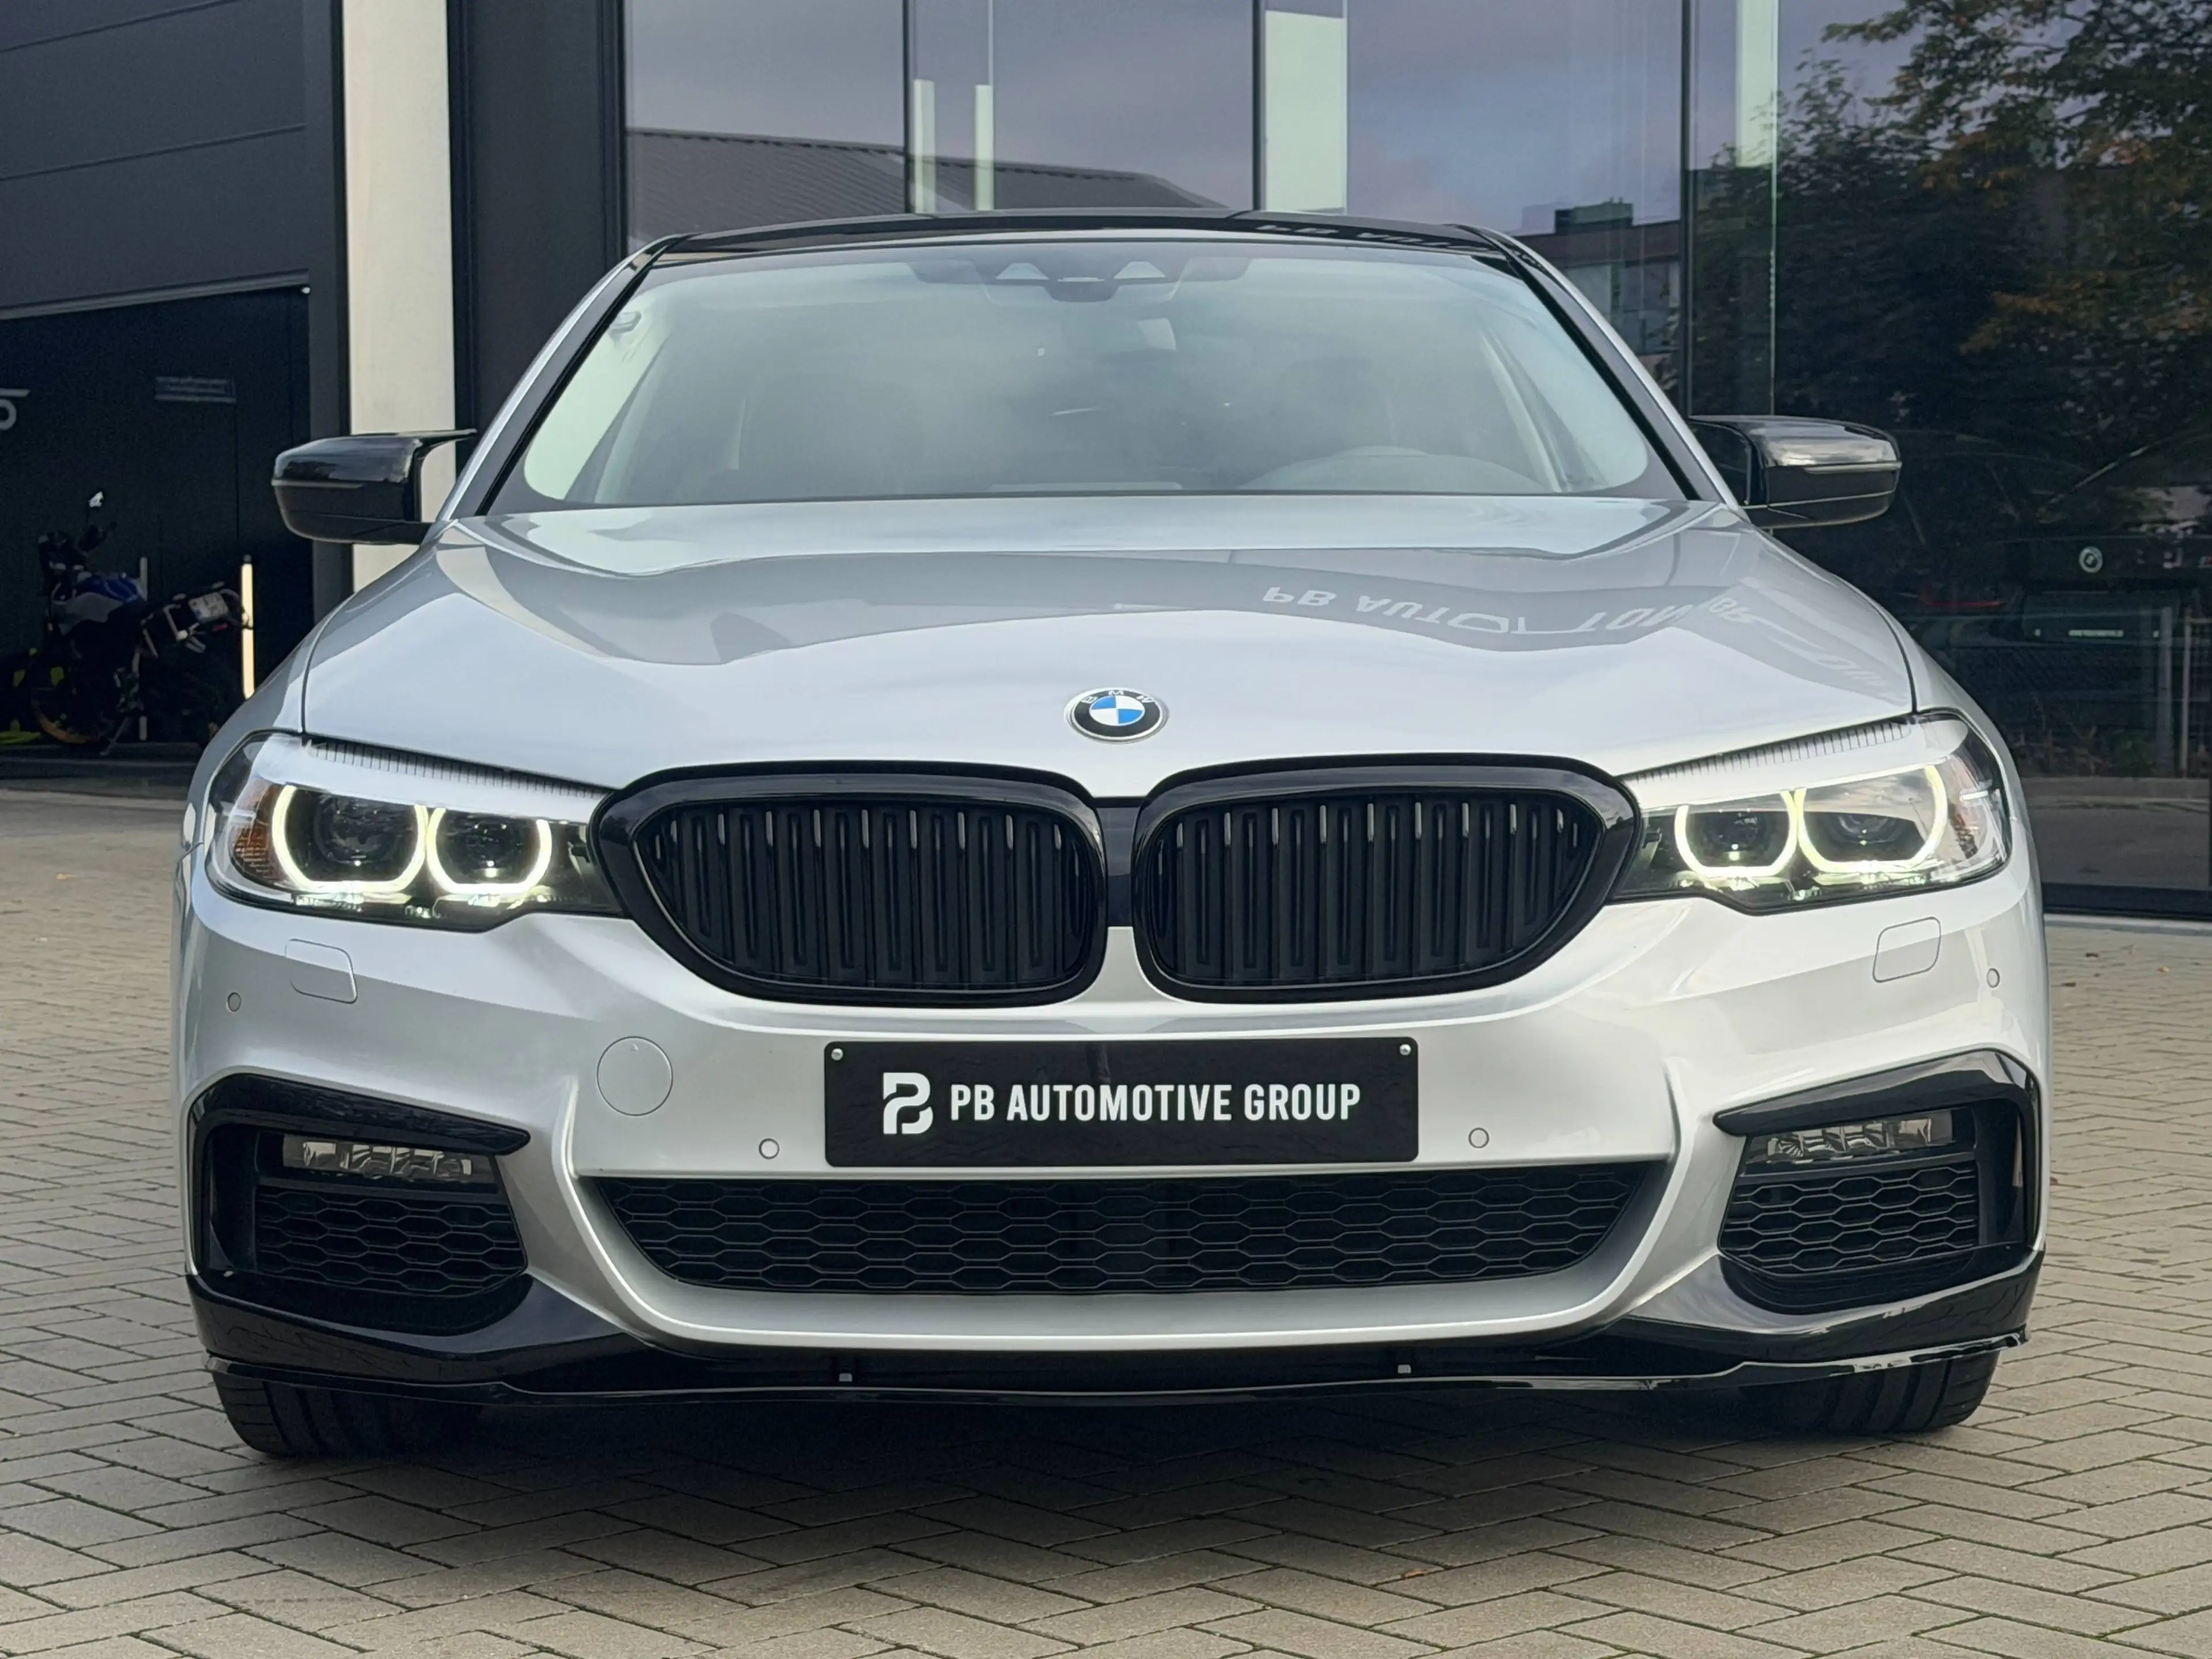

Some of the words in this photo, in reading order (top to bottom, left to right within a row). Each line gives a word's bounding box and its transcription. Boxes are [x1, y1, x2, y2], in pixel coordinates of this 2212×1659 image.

[1081, 690, 1155, 704] BMW
[950, 1084, 995, 1121] PB
[1006, 1084, 1232, 1122] AUTOMOTIVE
[1244, 1083, 1361, 1121] GROUP
